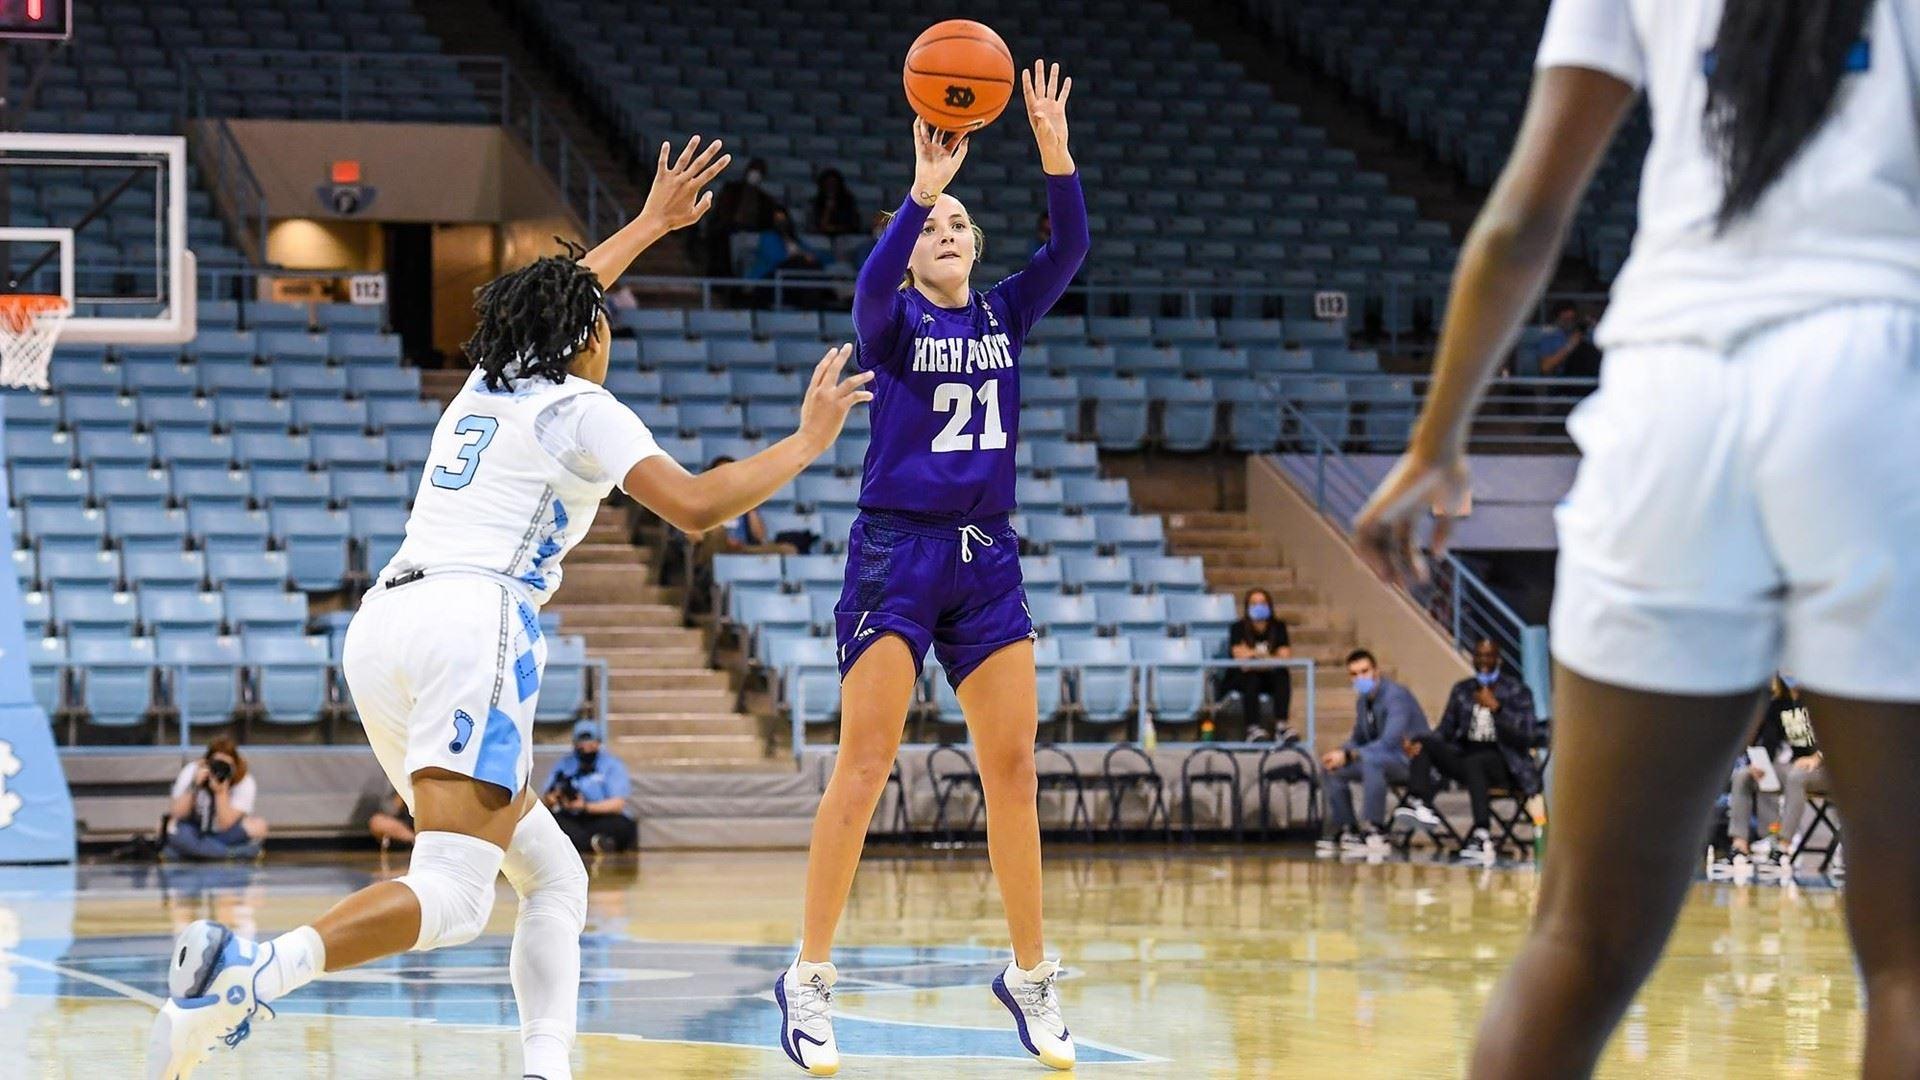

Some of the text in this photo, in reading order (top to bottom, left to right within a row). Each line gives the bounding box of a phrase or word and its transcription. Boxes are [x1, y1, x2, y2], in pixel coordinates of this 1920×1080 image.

[355, 281, 380, 298] 112
[912, 332, 1014, 374] HIGH PONT
[931, 379, 1007, 452] 21
[430, 414, 499, 490] 3
